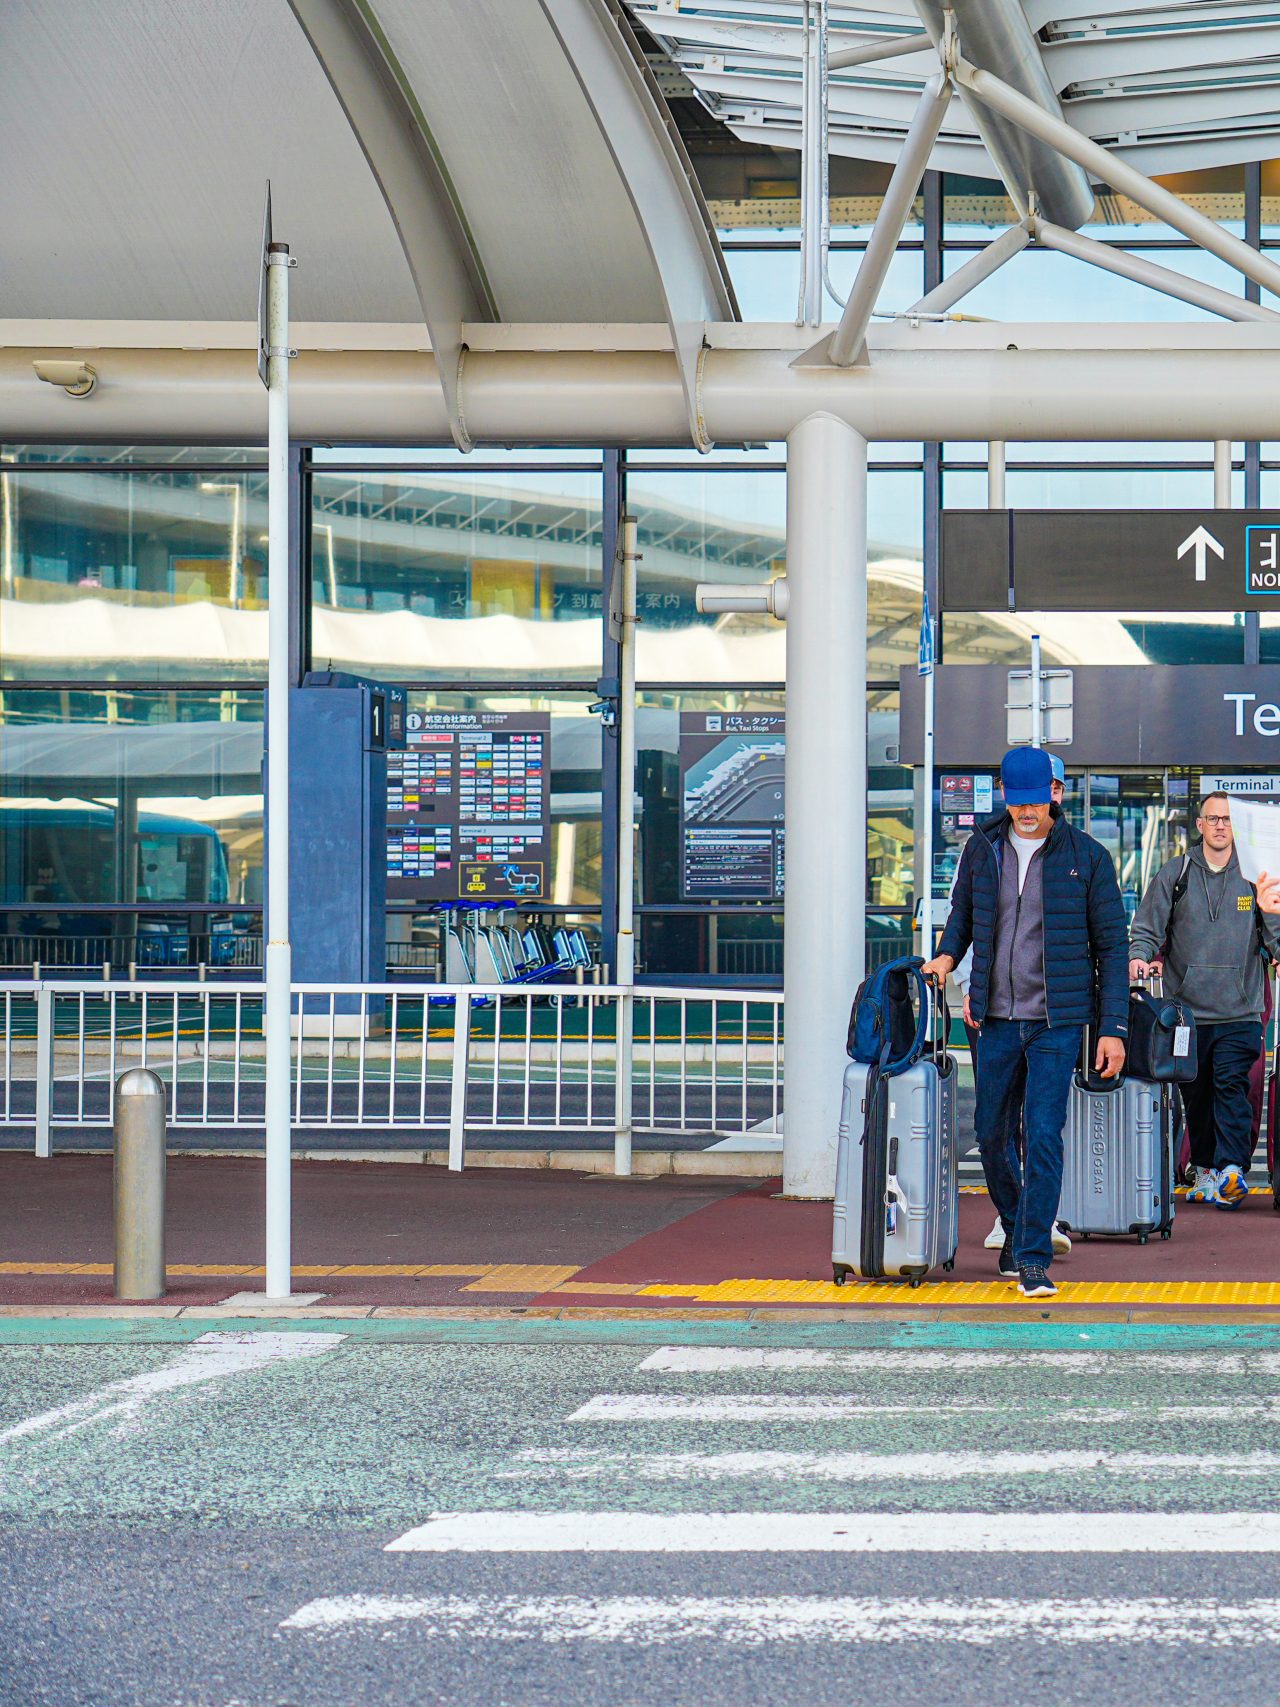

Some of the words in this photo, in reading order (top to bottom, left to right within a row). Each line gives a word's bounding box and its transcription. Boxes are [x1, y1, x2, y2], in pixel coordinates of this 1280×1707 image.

[373, 705, 379, 737] 1
[1214, 779, 1273, 790] Terminal
[1093, 1100, 1104, 1140] SWISS
[1093, 1158, 1104, 1193] GEAR
